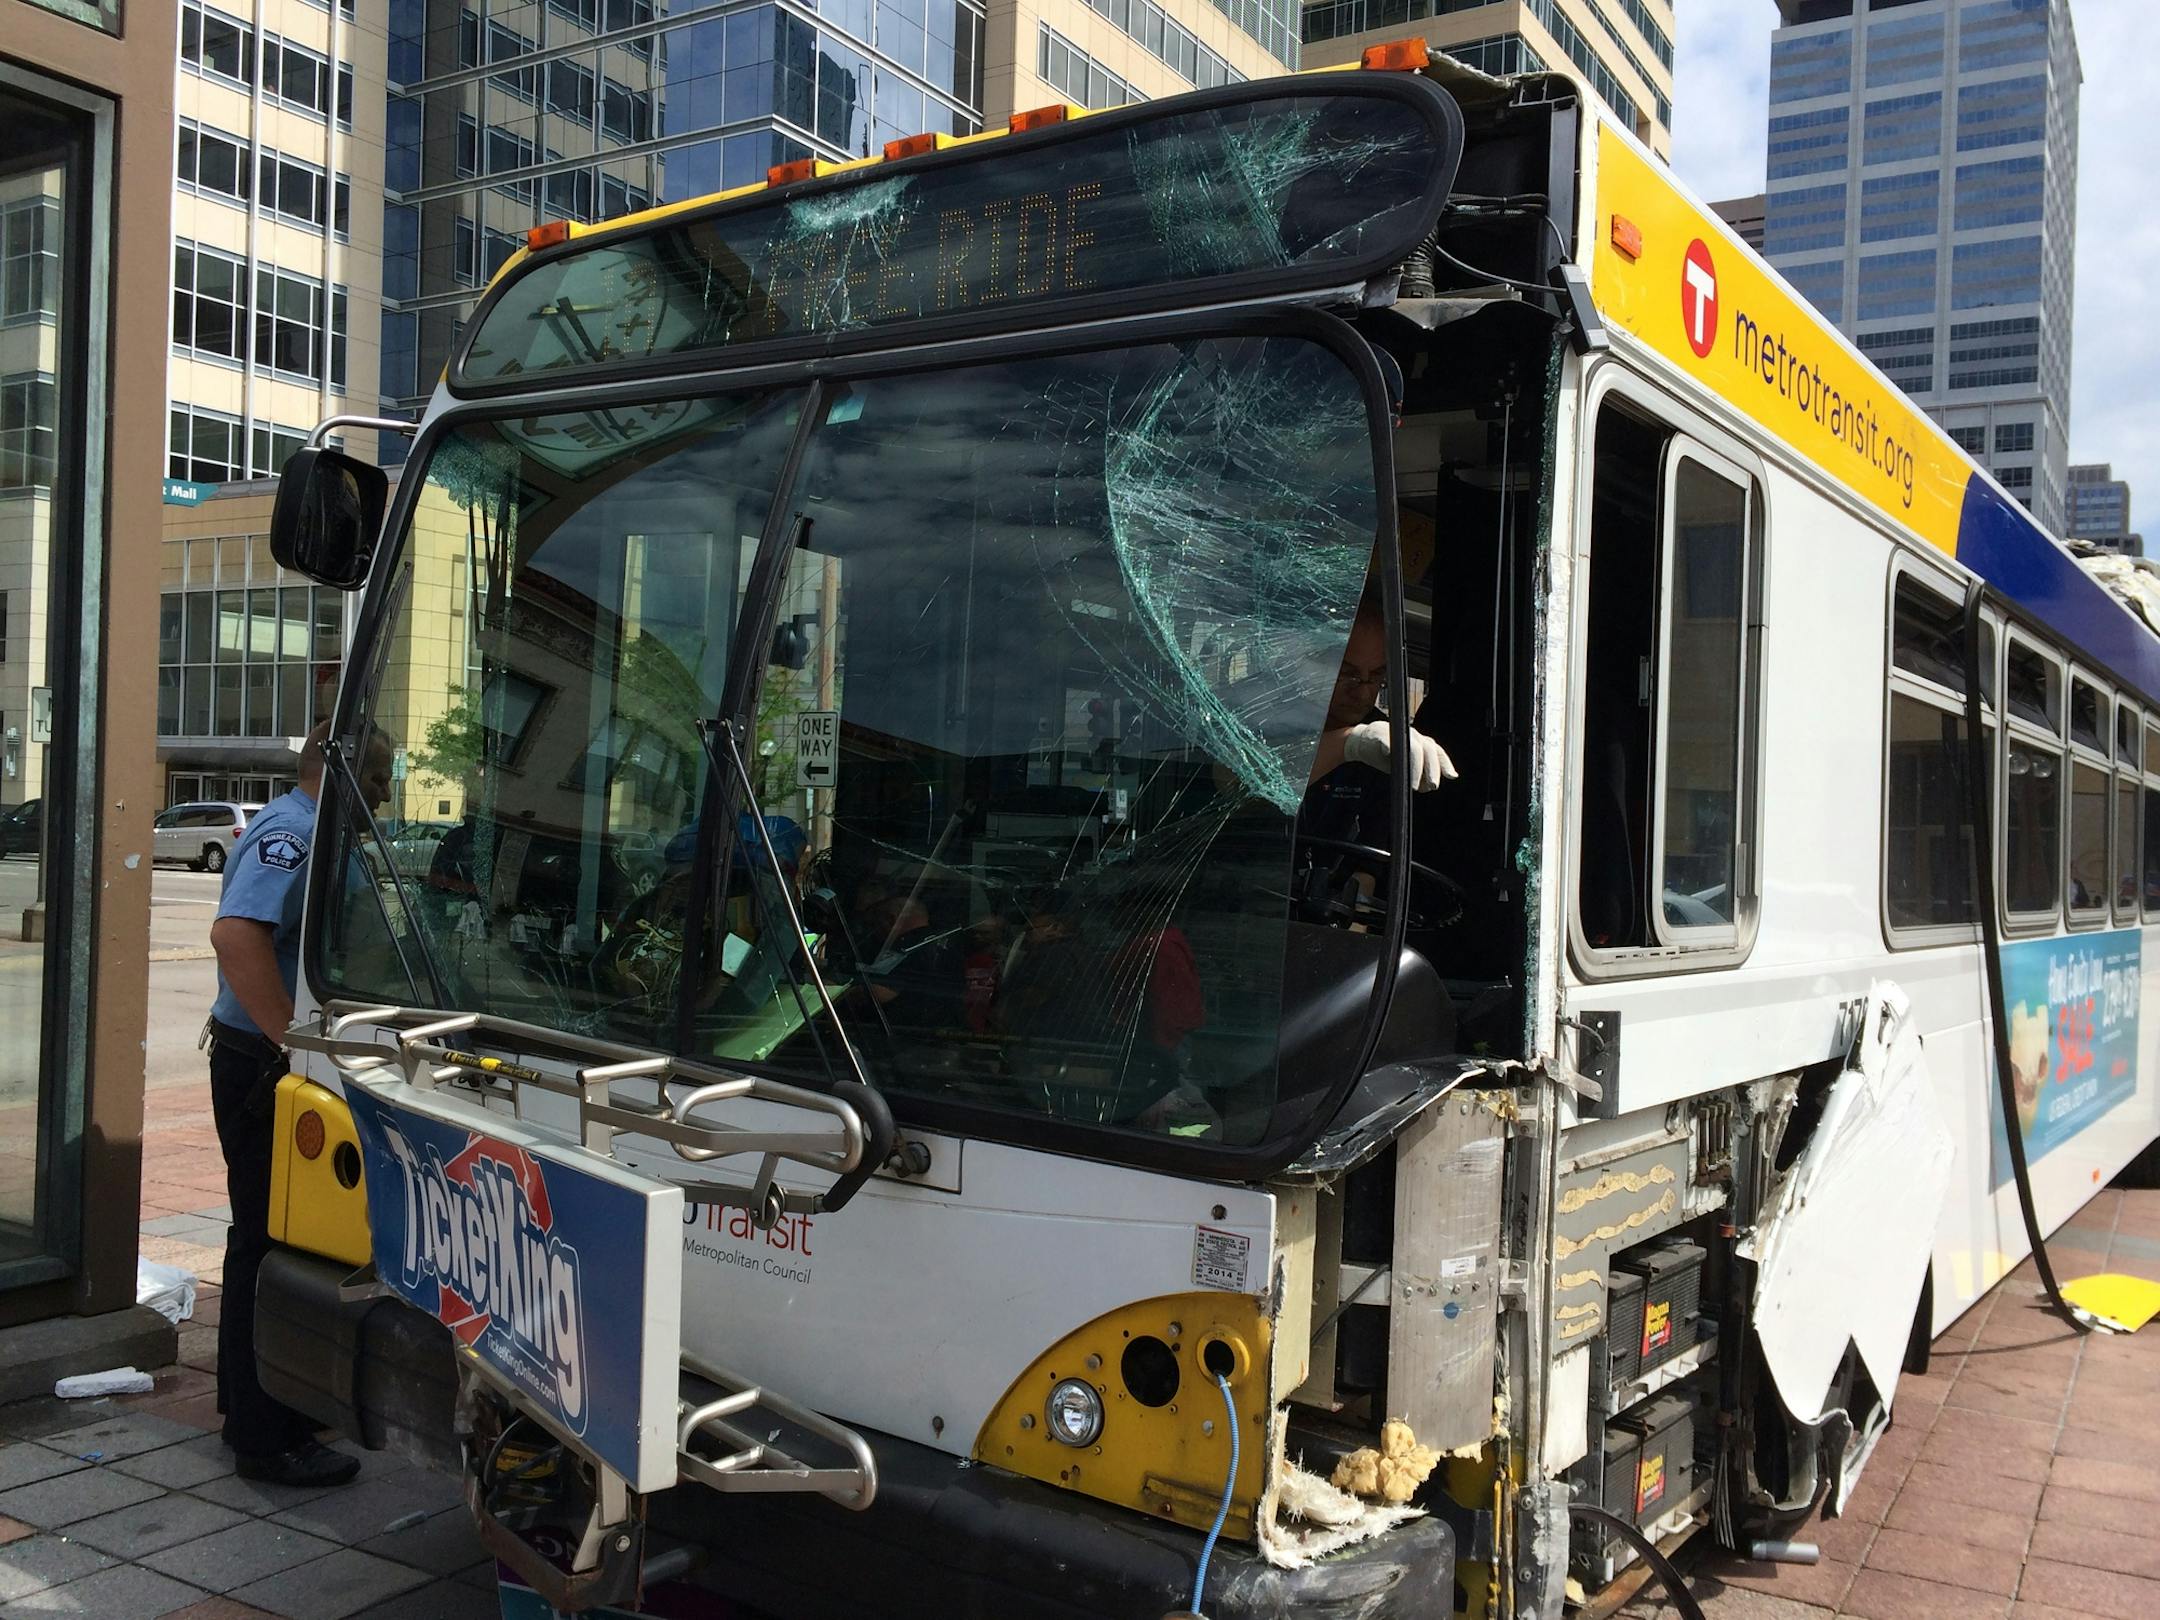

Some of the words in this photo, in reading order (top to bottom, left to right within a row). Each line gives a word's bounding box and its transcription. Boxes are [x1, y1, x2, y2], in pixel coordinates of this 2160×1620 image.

[936, 183, 1101, 309] RIDE
[1685, 255, 1716, 347] T
[1735, 309, 1914, 509] metrotransit.org
[171, 485, 197, 500] Mall
[802, 718, 831, 735] ONE
[801, 739, 832, 757] WAY
[262, 833, 307, 854] MINNEAPOLIS
[265, 856, 292, 868] POLICE
[683, 1237, 759, 1271] Metropolitan
[763, 1258, 812, 1284] Council
[1208, 1267, 1233, 1279] 2014
